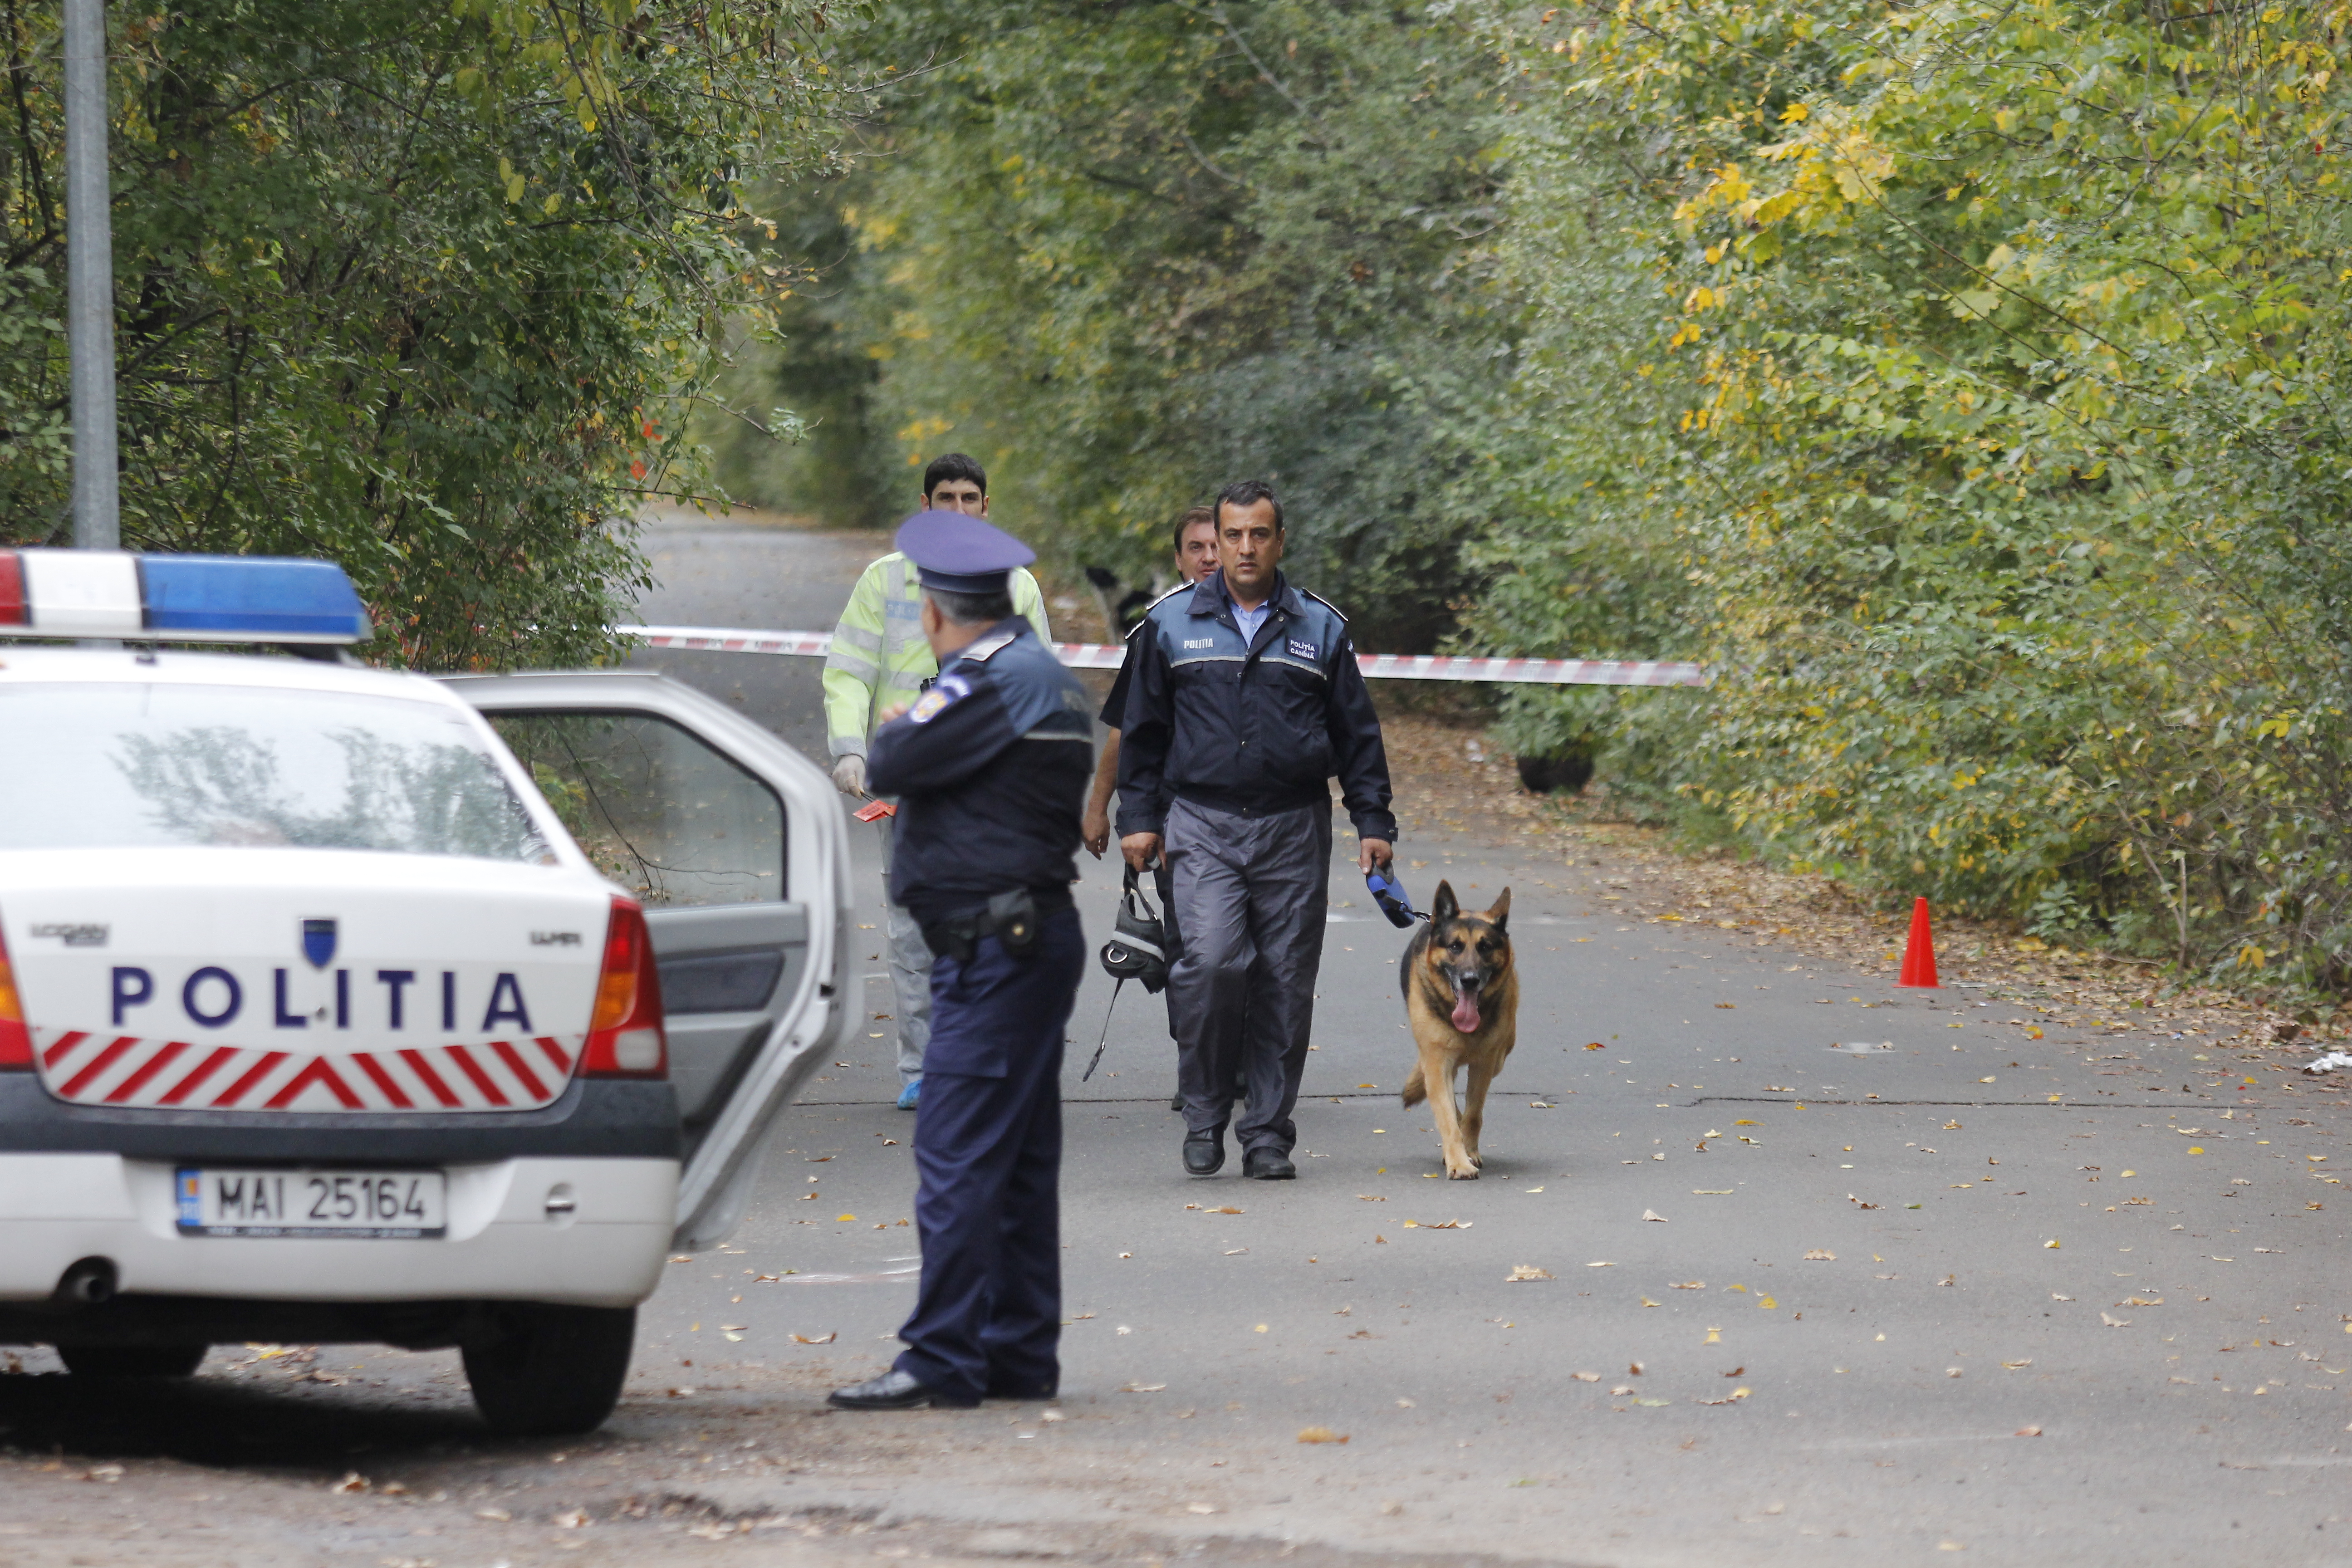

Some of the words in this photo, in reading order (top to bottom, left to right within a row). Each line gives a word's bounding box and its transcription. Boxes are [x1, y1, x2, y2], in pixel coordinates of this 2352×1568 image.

[1184, 638, 1214, 649] POLITIA
[112, 965, 532, 1033] POLITIA
[219, 1178, 284, 1219] MAI
[309, 1178, 424, 1220] 25164
